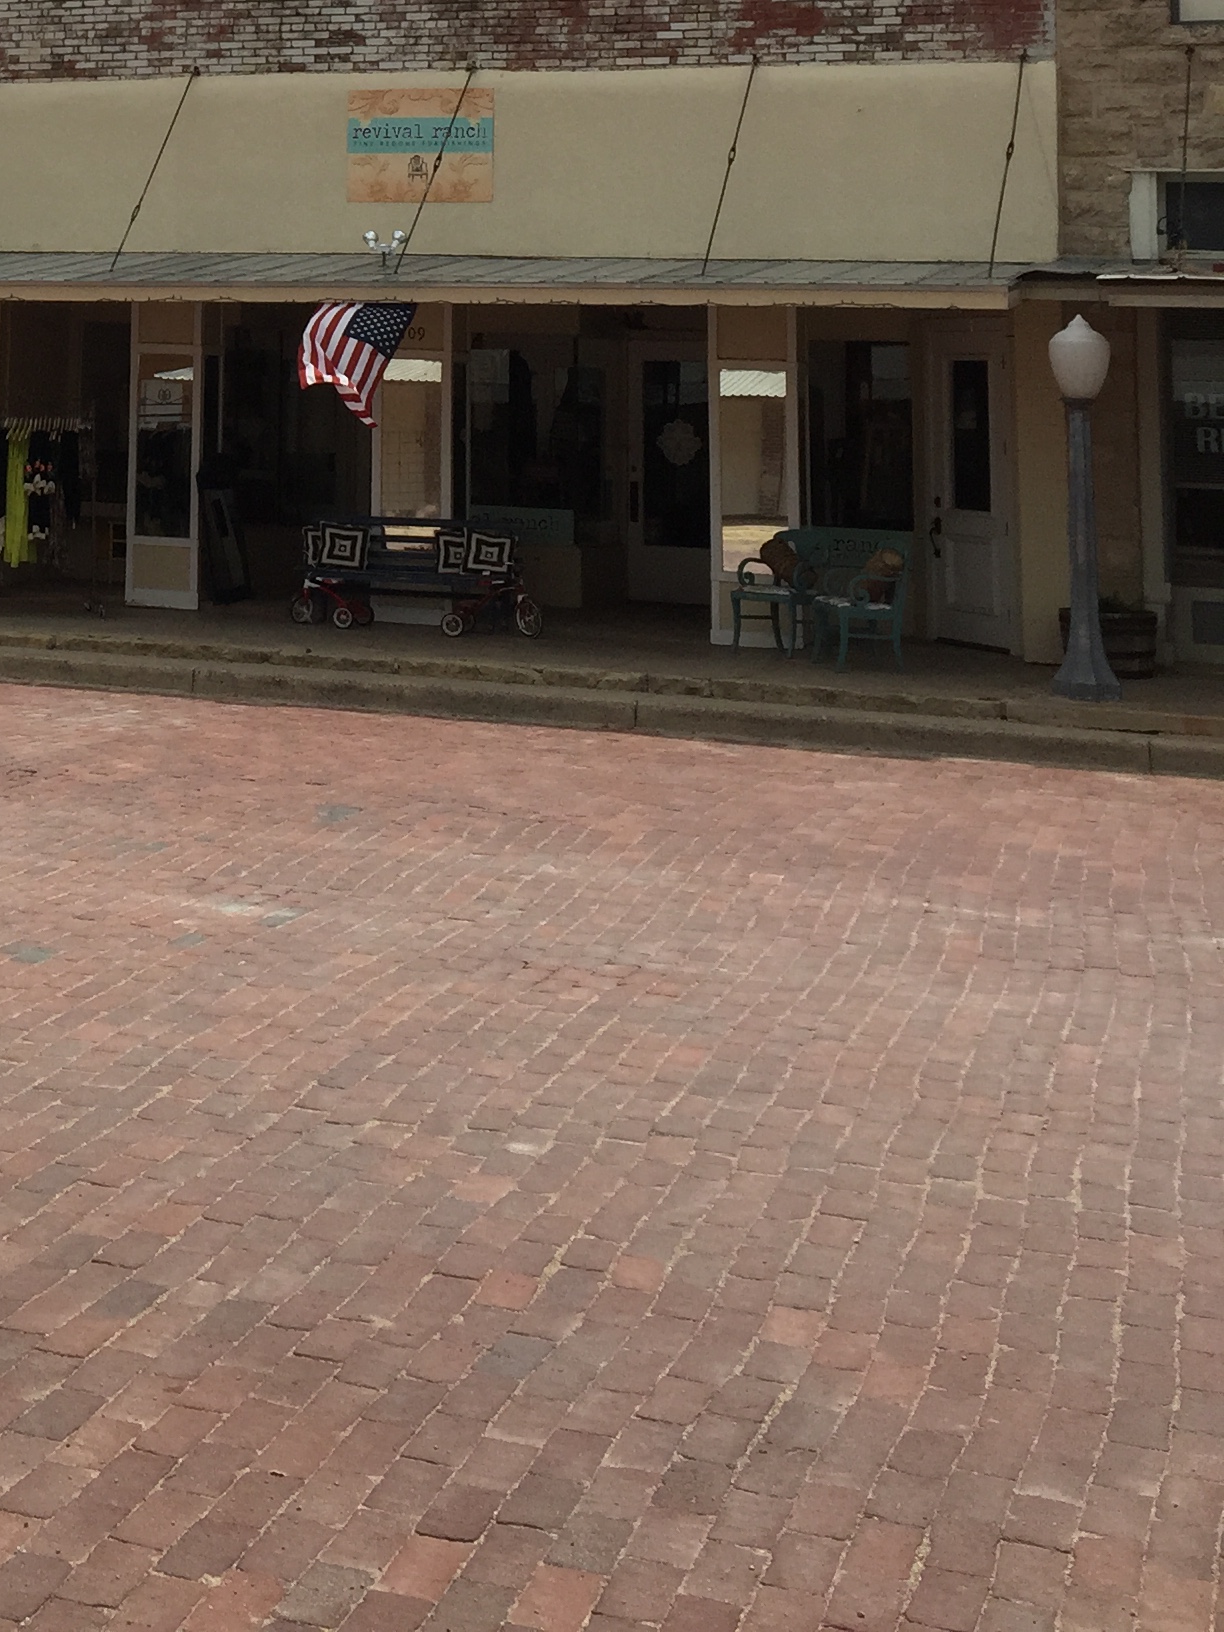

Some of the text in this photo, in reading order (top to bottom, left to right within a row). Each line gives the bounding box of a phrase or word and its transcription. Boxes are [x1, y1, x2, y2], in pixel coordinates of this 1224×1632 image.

[352, 122, 489, 139] revival ranch
[407, 326, 425, 341] 09
